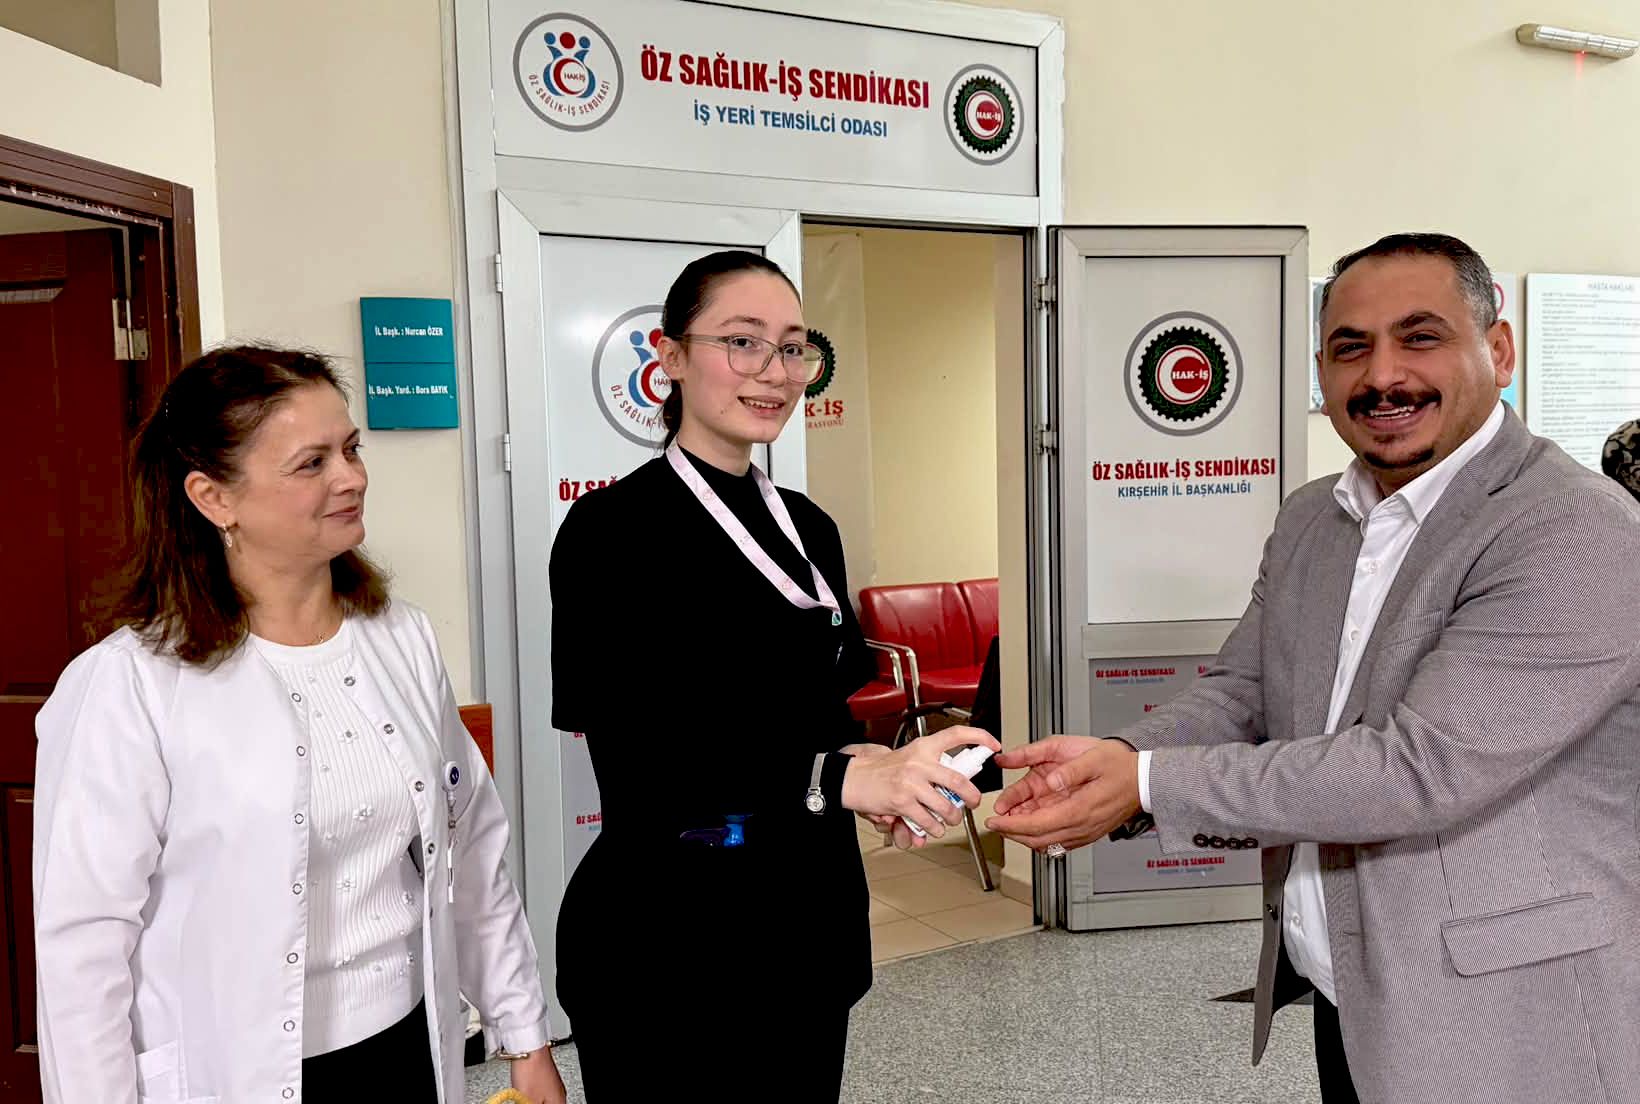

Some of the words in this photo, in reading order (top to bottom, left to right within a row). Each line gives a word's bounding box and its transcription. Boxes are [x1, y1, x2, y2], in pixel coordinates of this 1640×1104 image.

[641, 43, 673, 83] ÖZ
[678, 51, 803, 102] SAĞLIK-İŞ
[808, 69, 930, 109] SENDİKASI
[528, 73, 540, 87] ÖZ
[535, 87, 577, 117] SAĞLIK-İŞ
[578, 80, 610, 115] SENDİKASI
[693, 99, 711, 126] İŞ
[715, 105, 756, 126] YERİ
[760, 109, 836, 134] TEMSİLCİ
[840, 117, 888, 138] ODASI
[405, 326, 427, 337] Nurcan
[427, 324, 444, 337] ÖZER
[1171, 368, 1210, 381] HAK-İŞ
[610, 384, 624, 400] ÖZ
[1092, 461, 1111, 481] ÖZ
[1115, 458, 1191, 483] SAĞLIK-İŞ
[1195, 456, 1276, 477] SENDİKASI
[558, 477, 581, 502] ÖZ
[1118, 483, 1169, 500] KIRŞEHİR
[1172, 482, 1183, 496] İL
[1185, 479, 1252, 498] BAŞKANLIĞI
